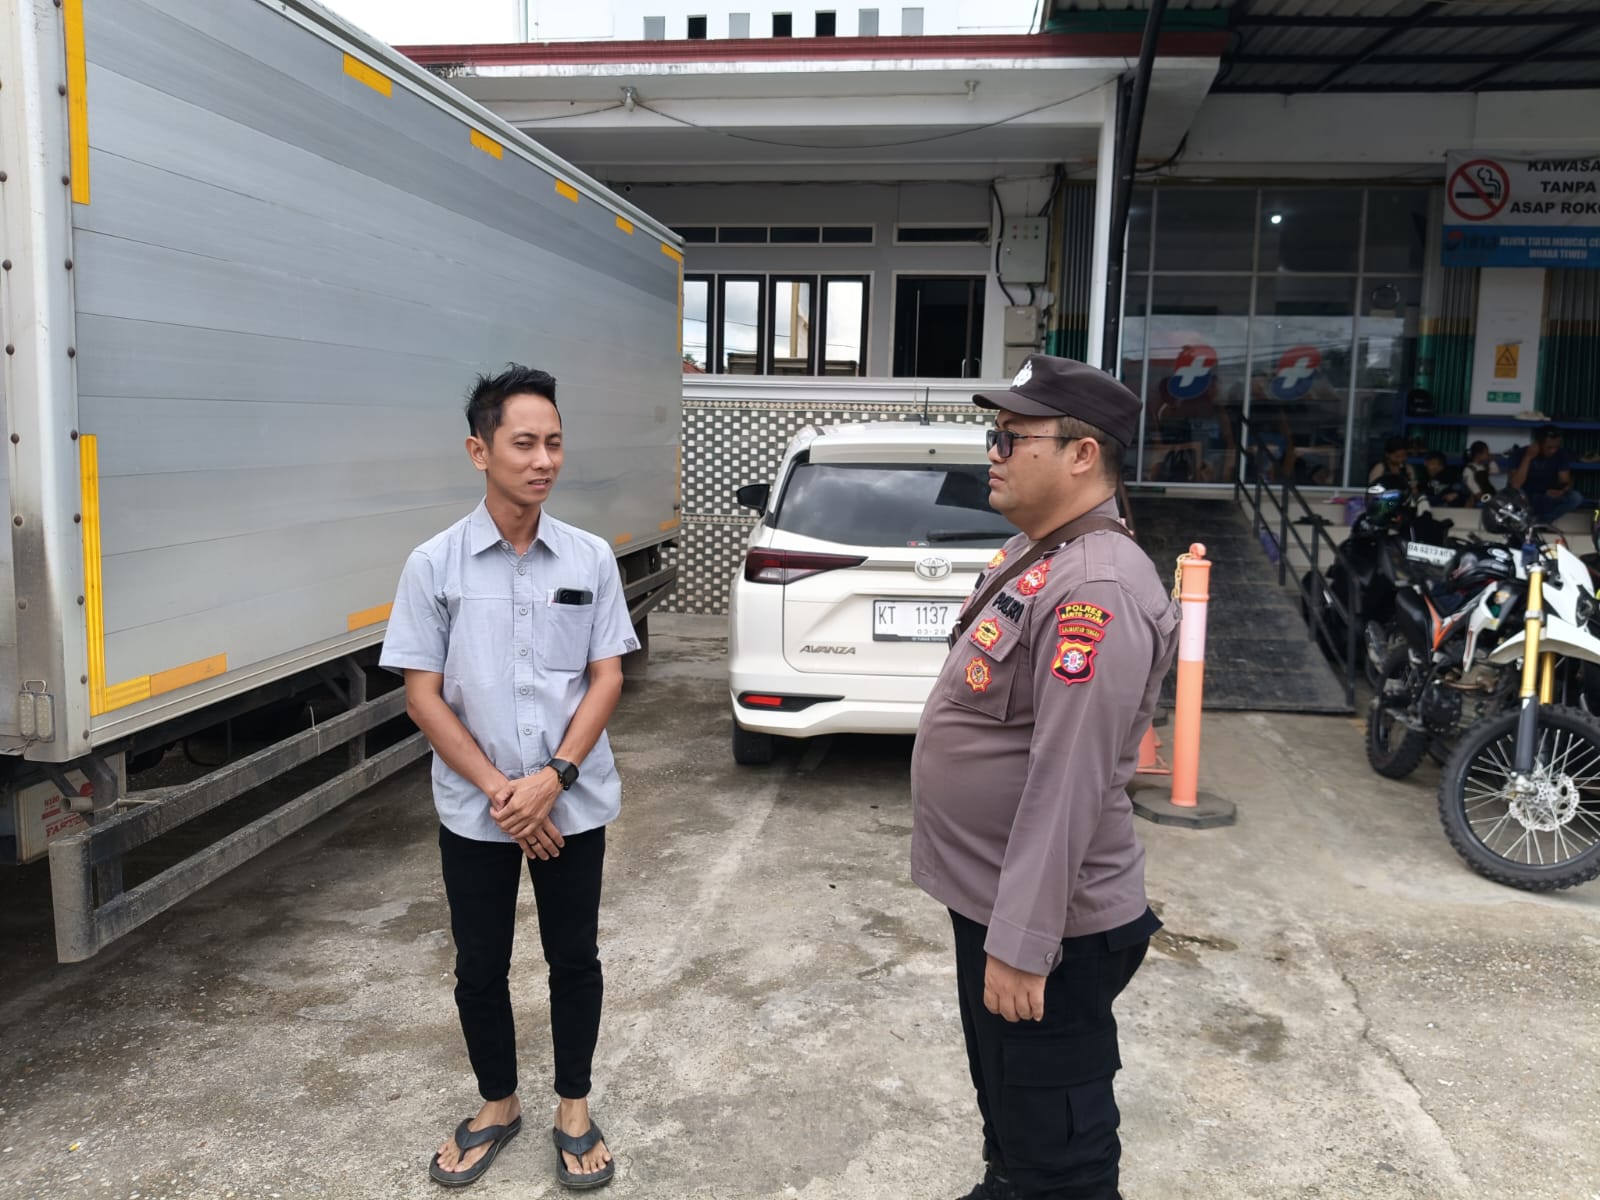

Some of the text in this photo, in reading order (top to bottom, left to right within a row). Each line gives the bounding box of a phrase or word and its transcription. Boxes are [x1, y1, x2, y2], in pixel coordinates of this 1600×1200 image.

[1540, 181, 1597, 193] TANPA
[1510, 202, 1555, 214] ASAP
[878, 605, 948, 625] KT 1137
[1065, 604, 1103, 617] POLRES
[799, 644, 857, 655] AVANZA
